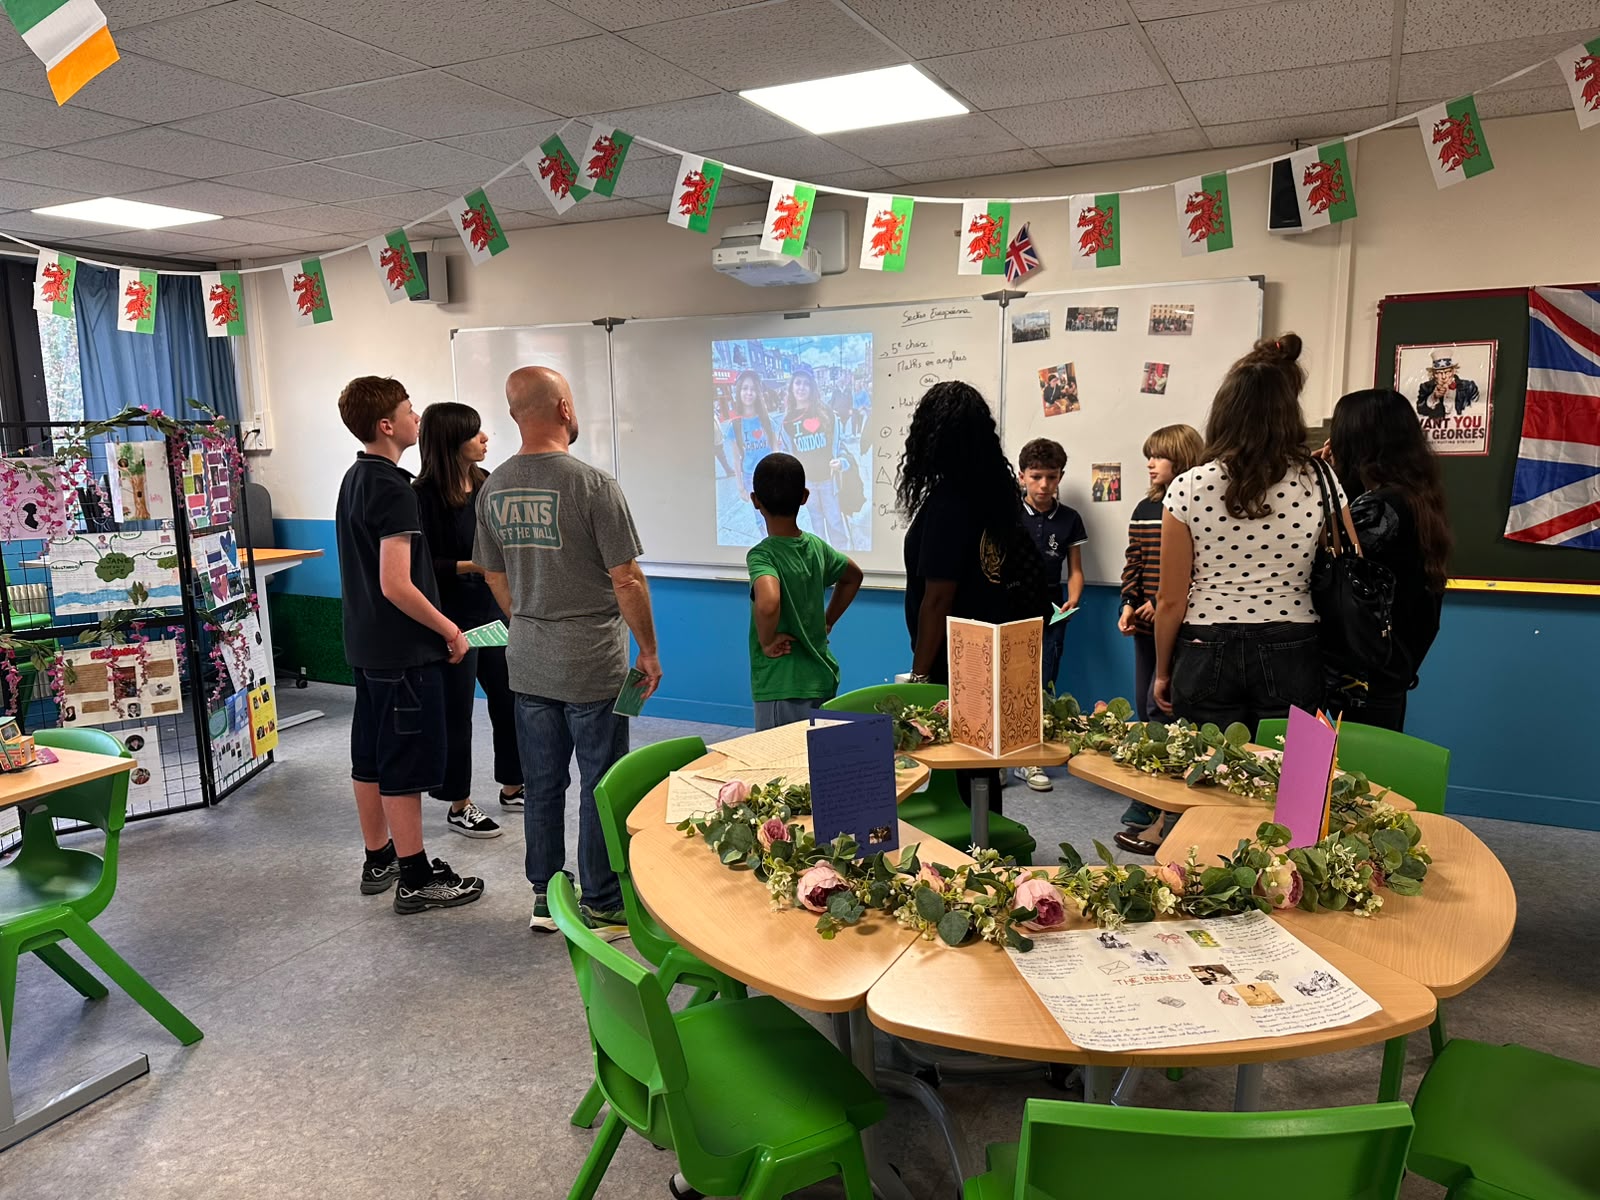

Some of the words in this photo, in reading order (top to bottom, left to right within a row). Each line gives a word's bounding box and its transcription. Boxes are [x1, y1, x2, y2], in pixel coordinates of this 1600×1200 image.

[1453, 415, 1482, 429] YOU
[793, 421, 803, 437] I
[1432, 427, 1485, 440] GEORGES
[744, 431, 750, 442] I
[743, 439, 768, 451] ONDON
[491, 495, 553, 527] VANS
[533, 527, 556, 540] WALL
[106, 556, 132, 564] JANE
[1112, 977, 1137, 985] THE
